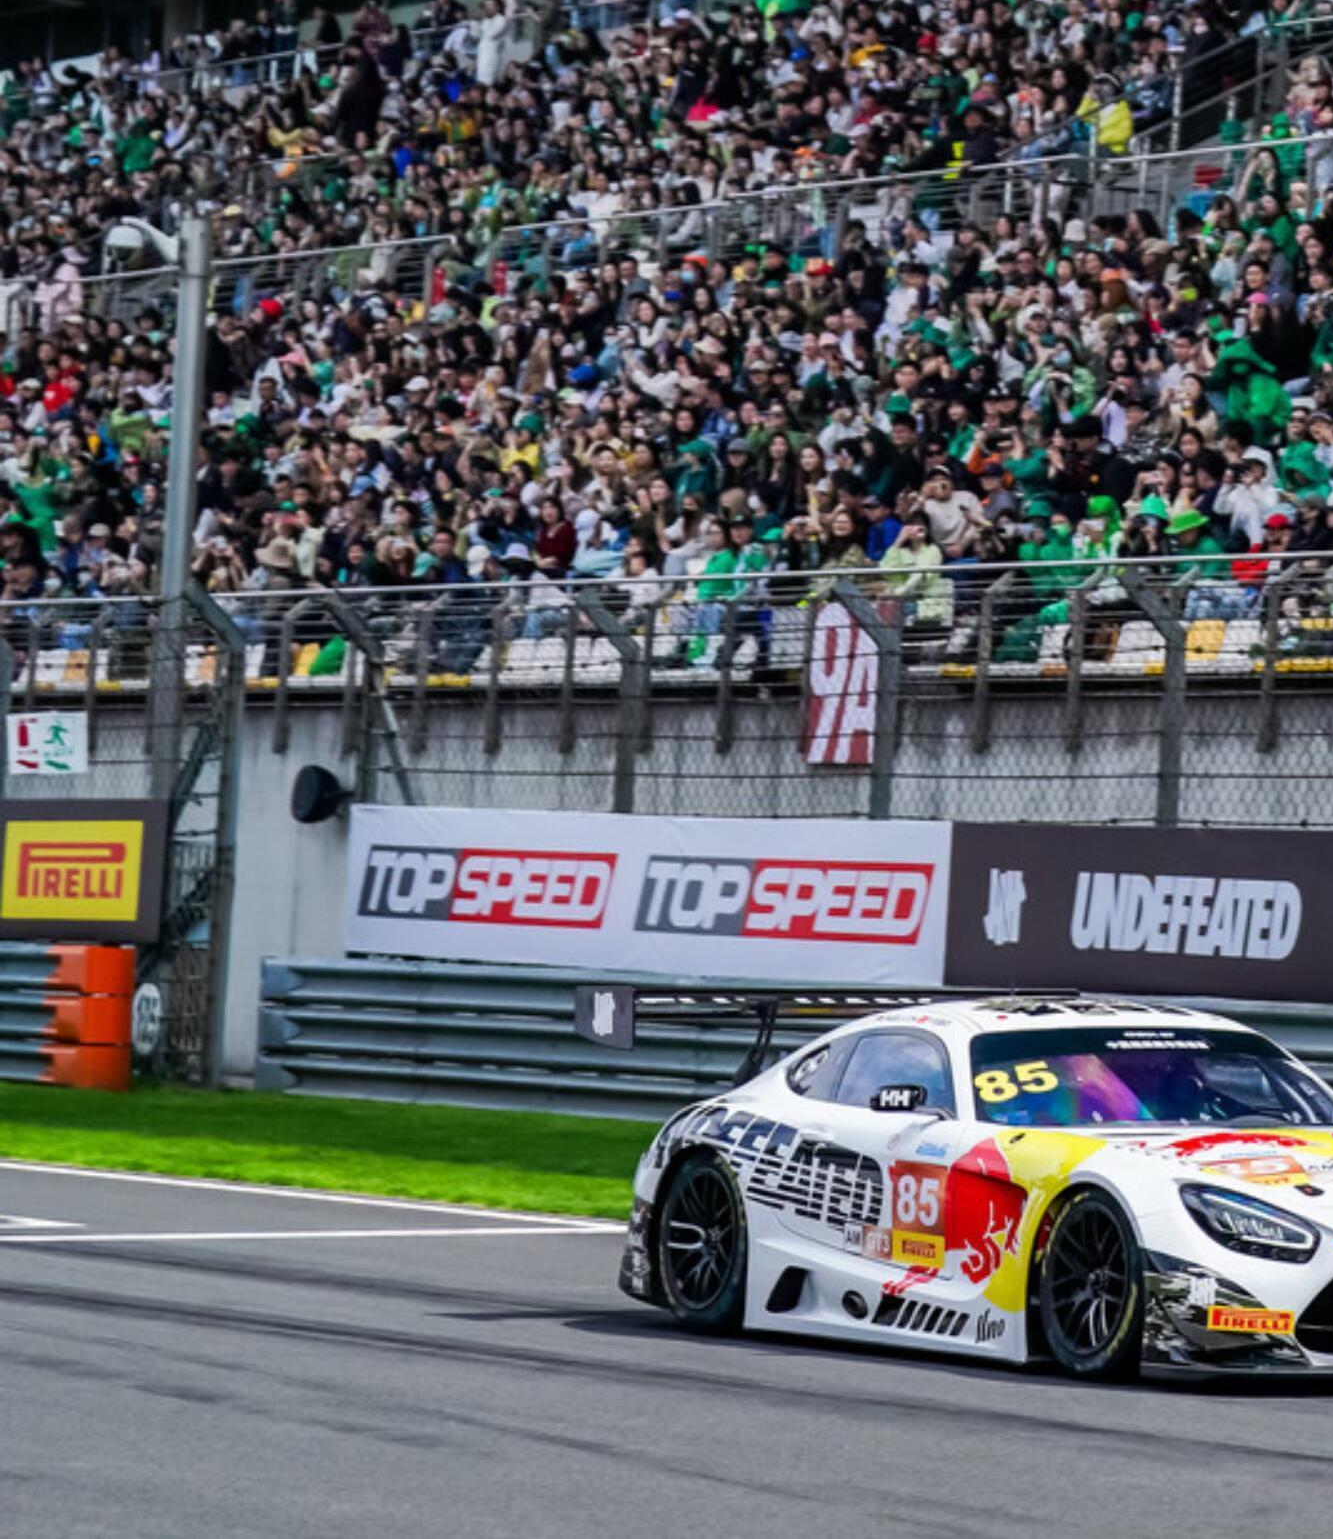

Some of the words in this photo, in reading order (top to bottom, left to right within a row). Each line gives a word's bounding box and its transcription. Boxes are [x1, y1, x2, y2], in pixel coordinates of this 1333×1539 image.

[808, 602, 875, 764] 9A
[18, 842, 127, 899] PIRELLI
[1071, 871, 1301, 959] UNDEFEATED
[974, 1061, 1058, 1101] 85
[897, 1175, 939, 1225] 85
[1212, 1308, 1292, 1331] PIRELLI
